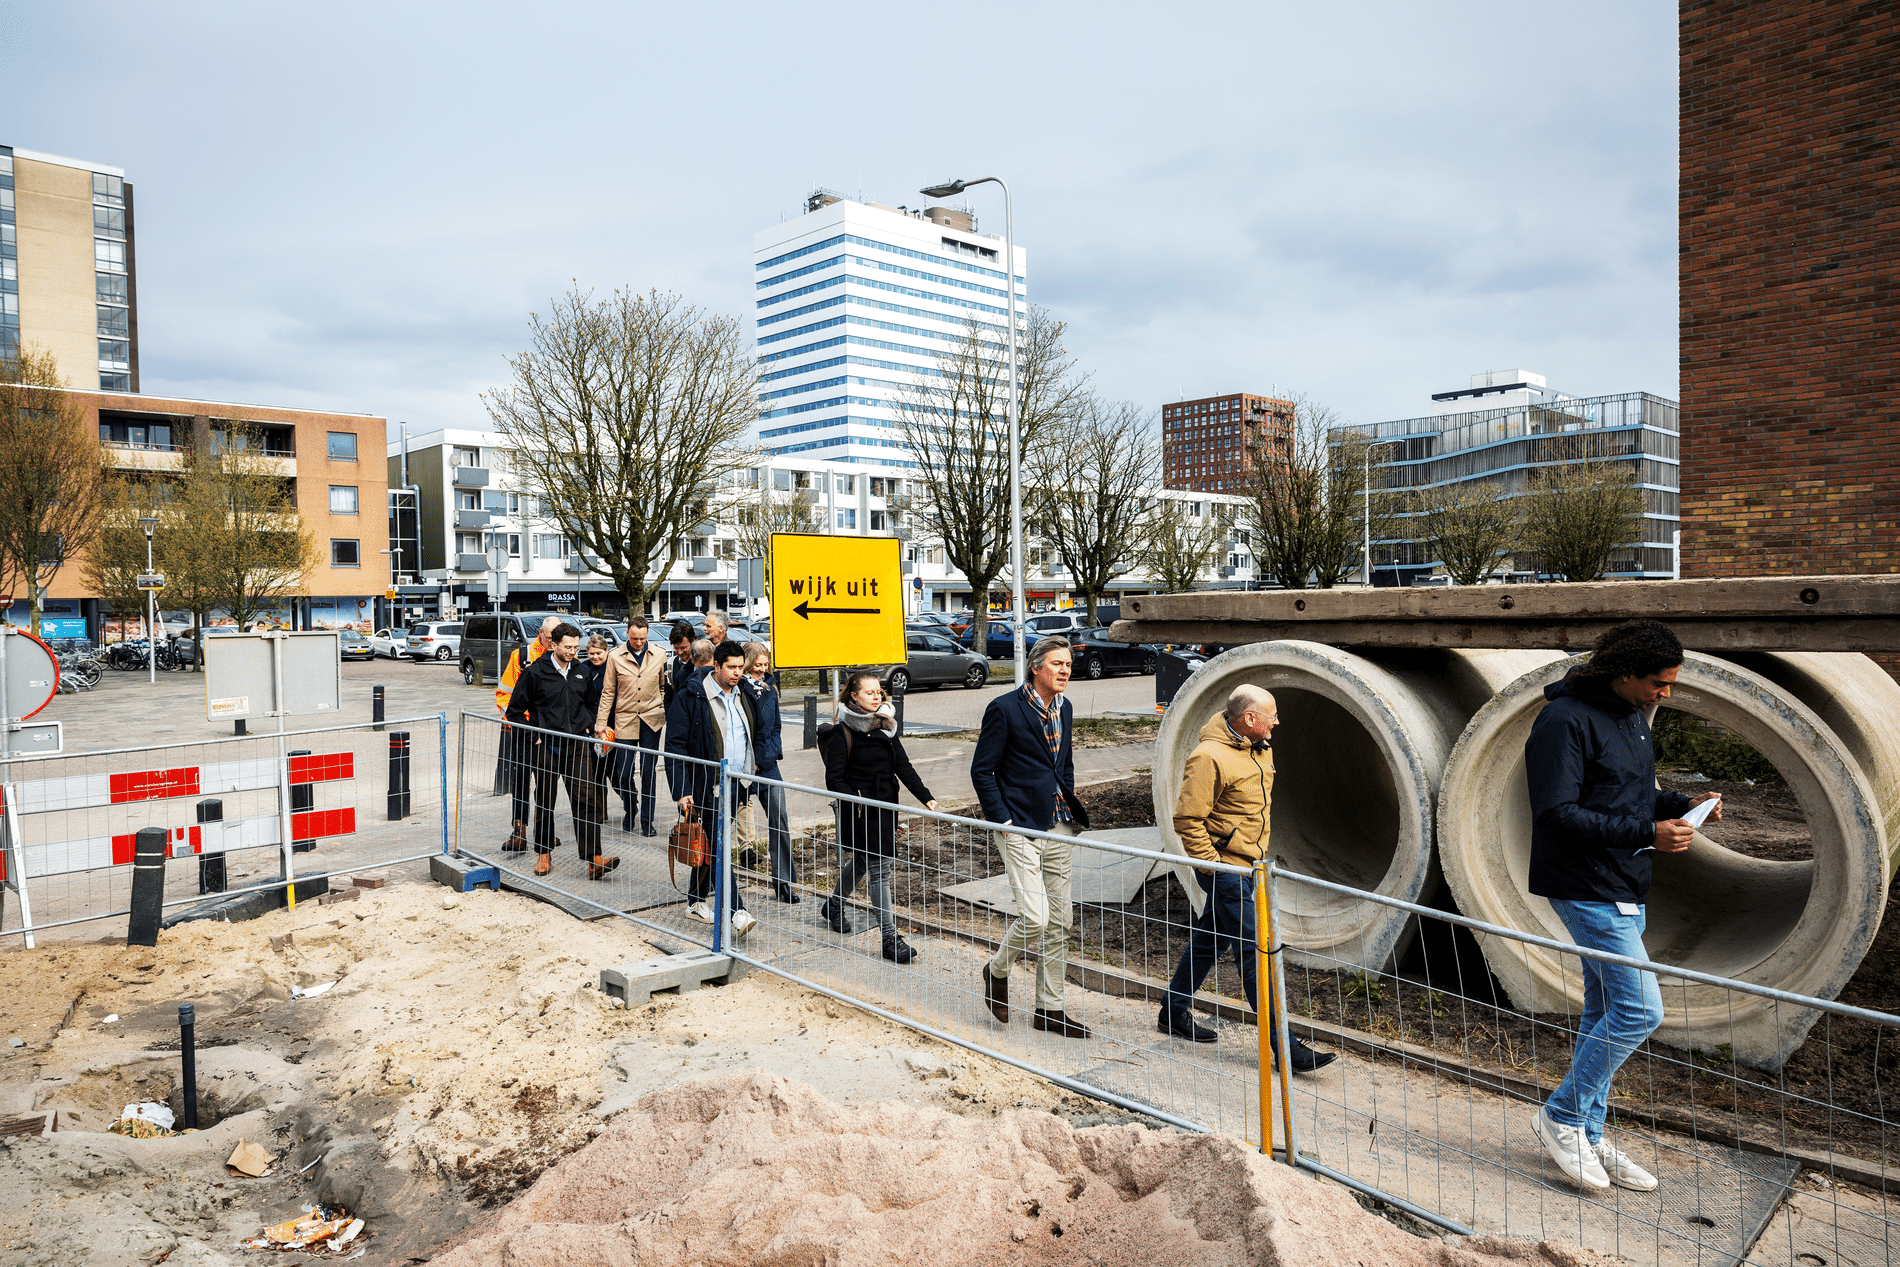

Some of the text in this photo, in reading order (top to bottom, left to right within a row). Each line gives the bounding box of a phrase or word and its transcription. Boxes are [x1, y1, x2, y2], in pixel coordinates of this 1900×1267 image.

[548, 593, 576, 601] BRASSA
[789, 575, 878, 602] wijk uit
